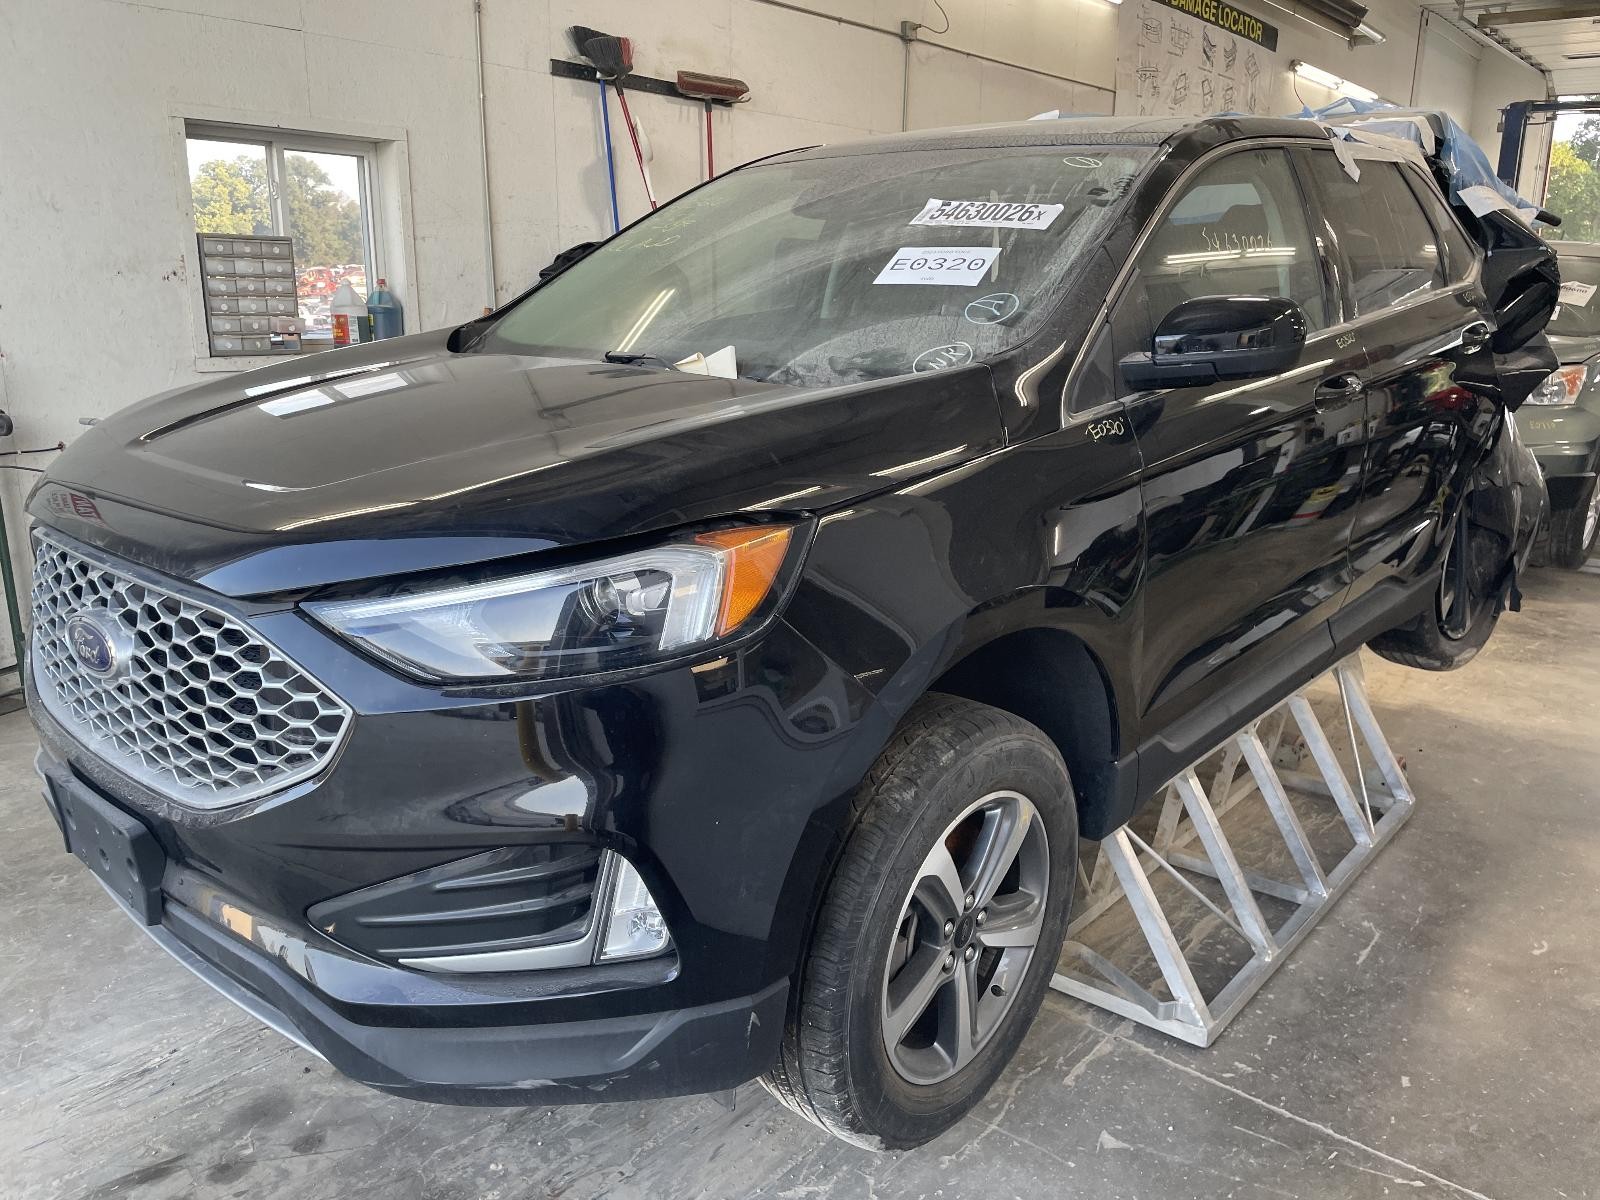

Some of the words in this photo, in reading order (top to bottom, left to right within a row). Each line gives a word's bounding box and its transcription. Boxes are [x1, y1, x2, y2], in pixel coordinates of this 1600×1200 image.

[1219, 5, 1263, 42] LOCATOR
[889, 258, 986, 271] E0320
[74, 627, 99, 664] Ford
